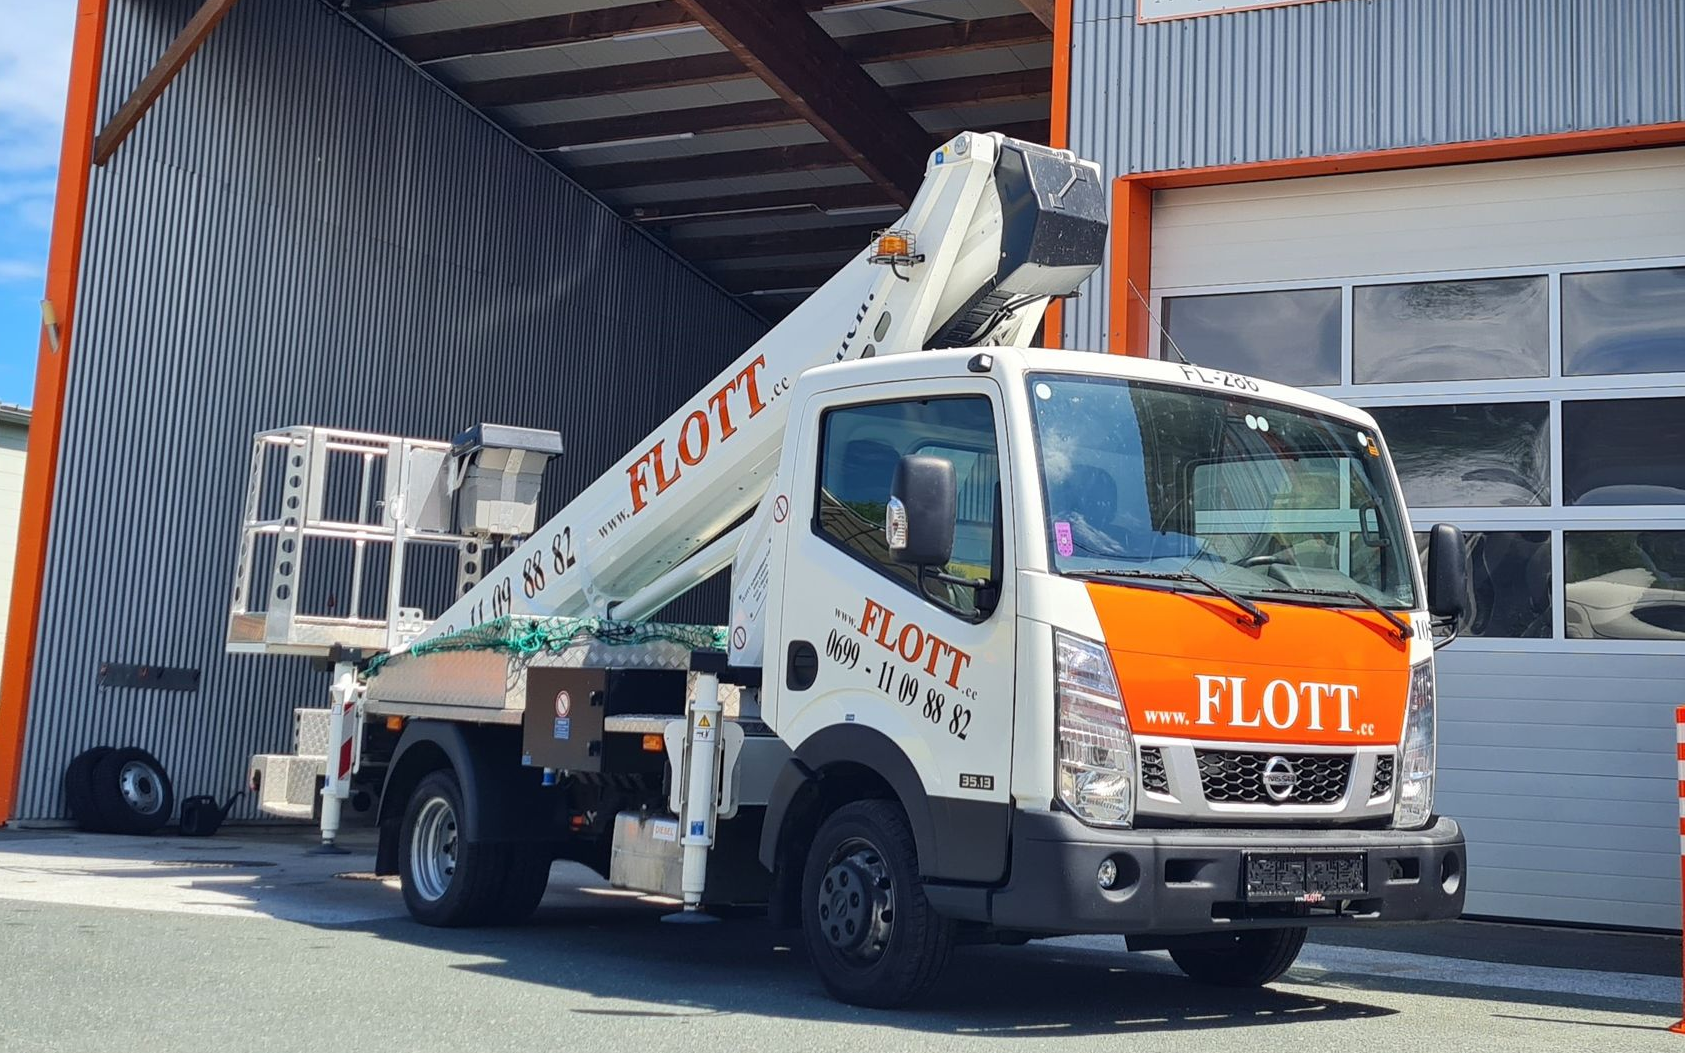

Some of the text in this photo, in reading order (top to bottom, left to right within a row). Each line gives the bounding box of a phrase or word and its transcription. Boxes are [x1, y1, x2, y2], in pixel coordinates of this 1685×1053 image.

[523, 550, 546, 599] 88
[552, 525, 577, 576] 82
[826, 627, 861, 671] 0699
[877, 660, 895, 695] 11
[898, 672, 919, 706] 09
[922, 687, 946, 725] 88
[948, 703, 972, 741] 82
[961, 775, 992, 789] 35.13
